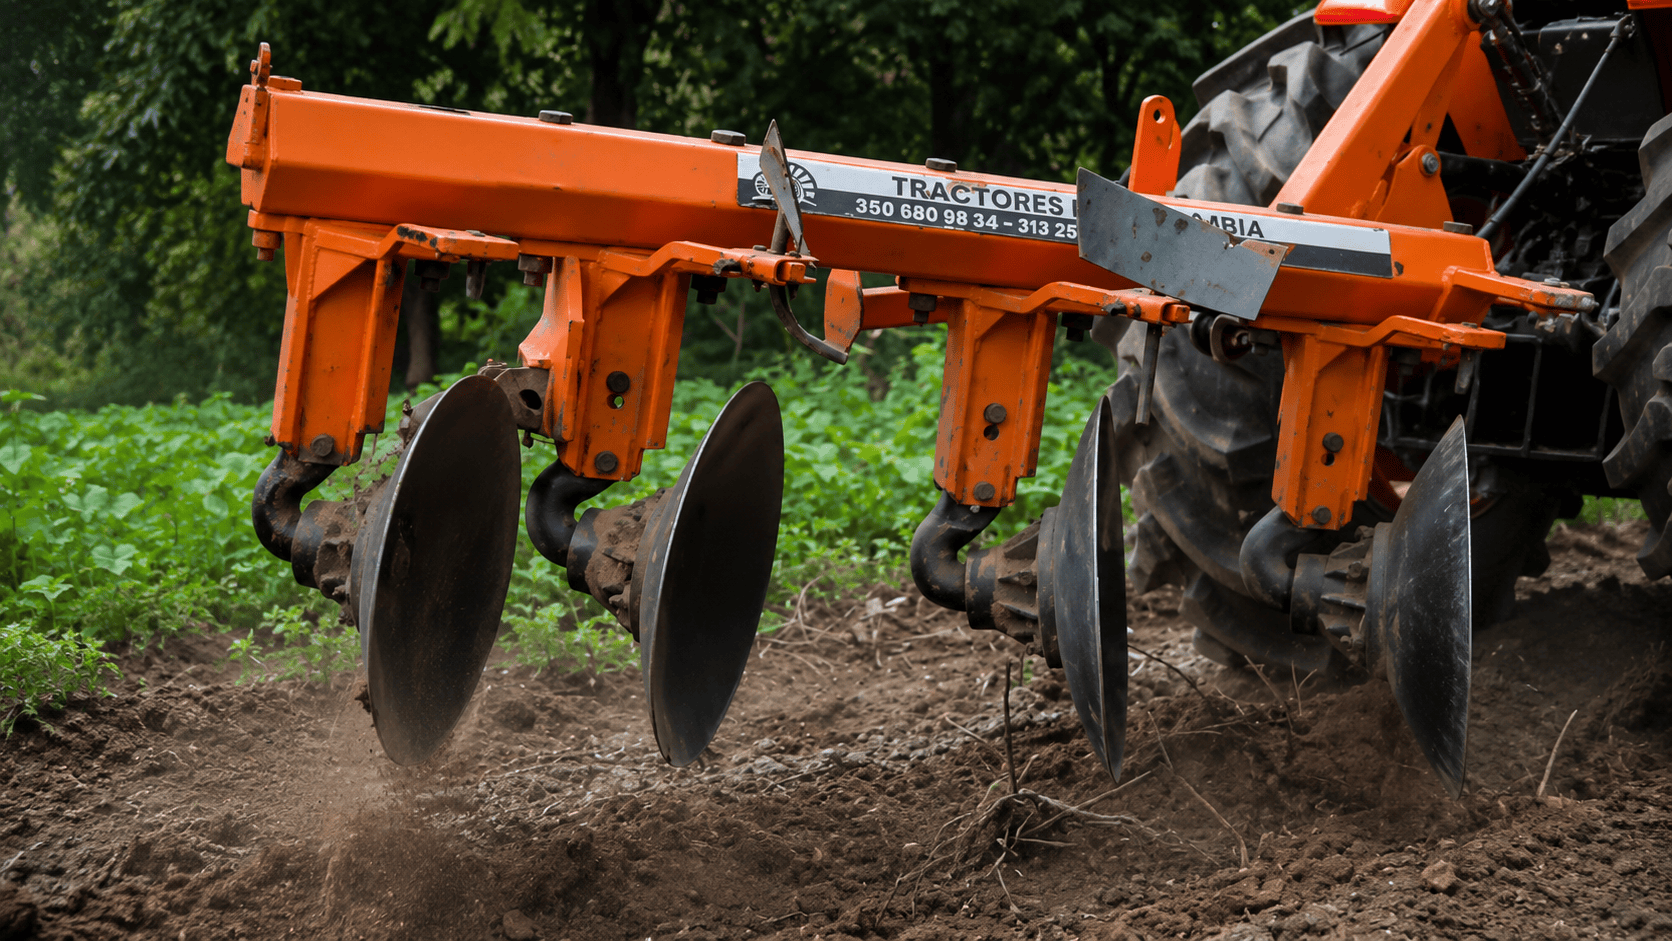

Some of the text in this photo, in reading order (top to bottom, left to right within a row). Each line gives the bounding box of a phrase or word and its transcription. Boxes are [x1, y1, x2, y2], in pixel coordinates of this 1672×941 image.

[892, 176, 1064, 216] TRACTORES
[855, 198, 894, 217] 350
[900, 203, 938, 222] 680
[943, 209, 968, 226] 98
[973, 213, 999, 230] 34
[1018, 218, 1049, 236] 313
